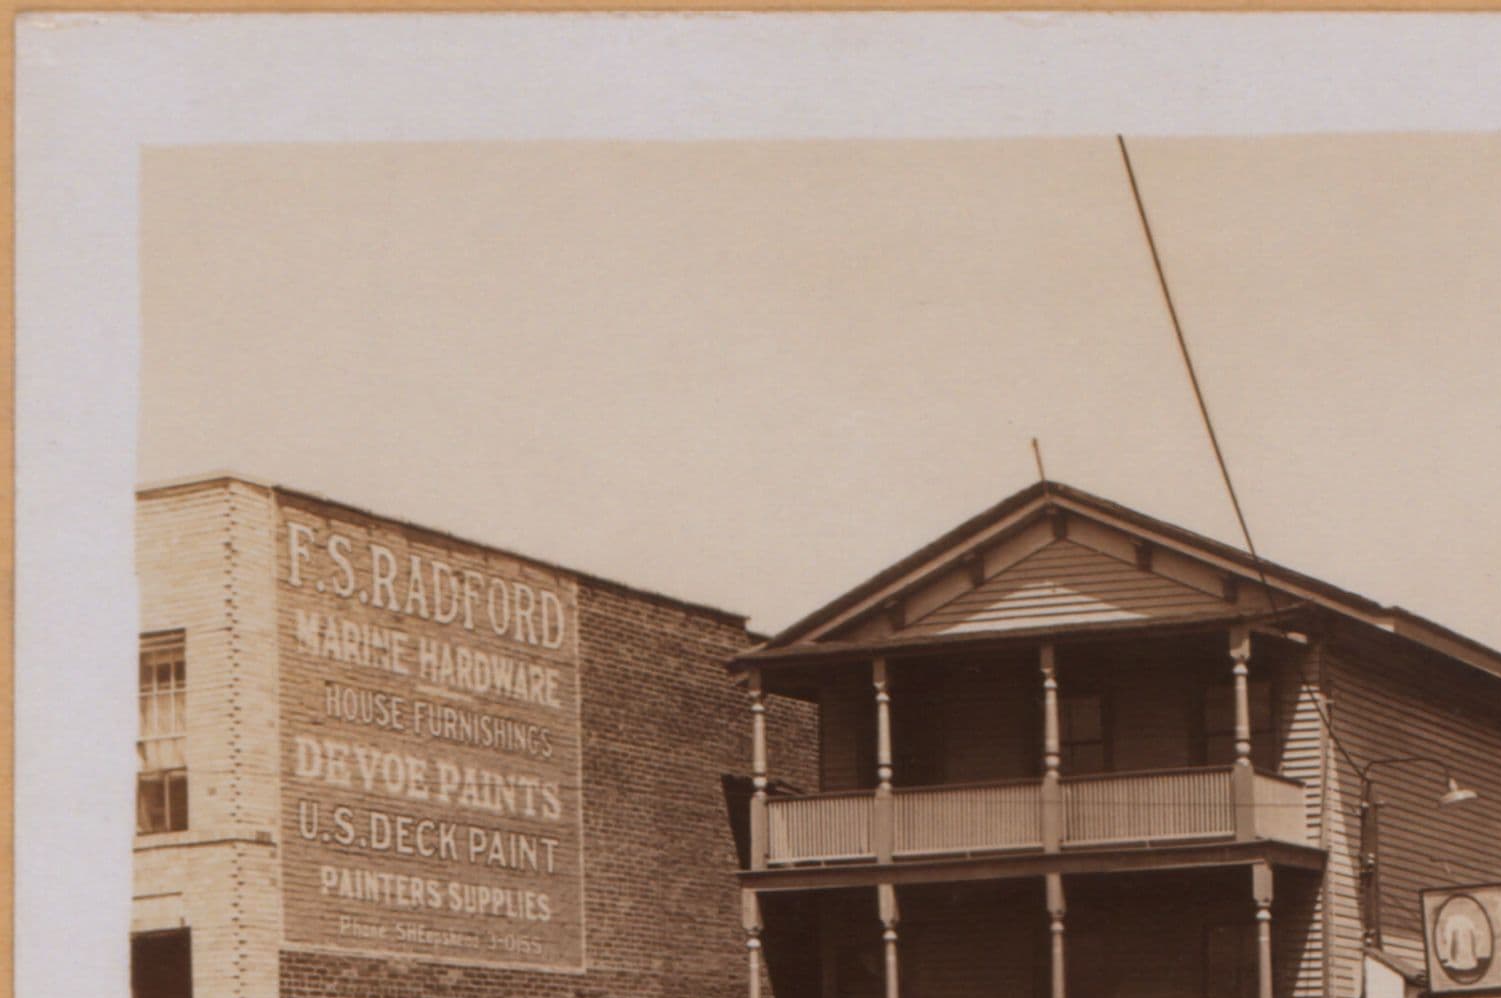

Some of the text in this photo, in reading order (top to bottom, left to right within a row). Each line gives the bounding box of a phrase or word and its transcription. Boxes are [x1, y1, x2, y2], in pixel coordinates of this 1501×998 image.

[295, 610, 561, 709] MARINE HARDWARE
[325, 684, 553, 758] HOUSE FURNISHINGS
[295, 735, 561, 822] DEVOE PAINTS
[468, 826, 560, 875] PAINT
[320, 865, 552, 922] PAINTERS SUPPLIES
